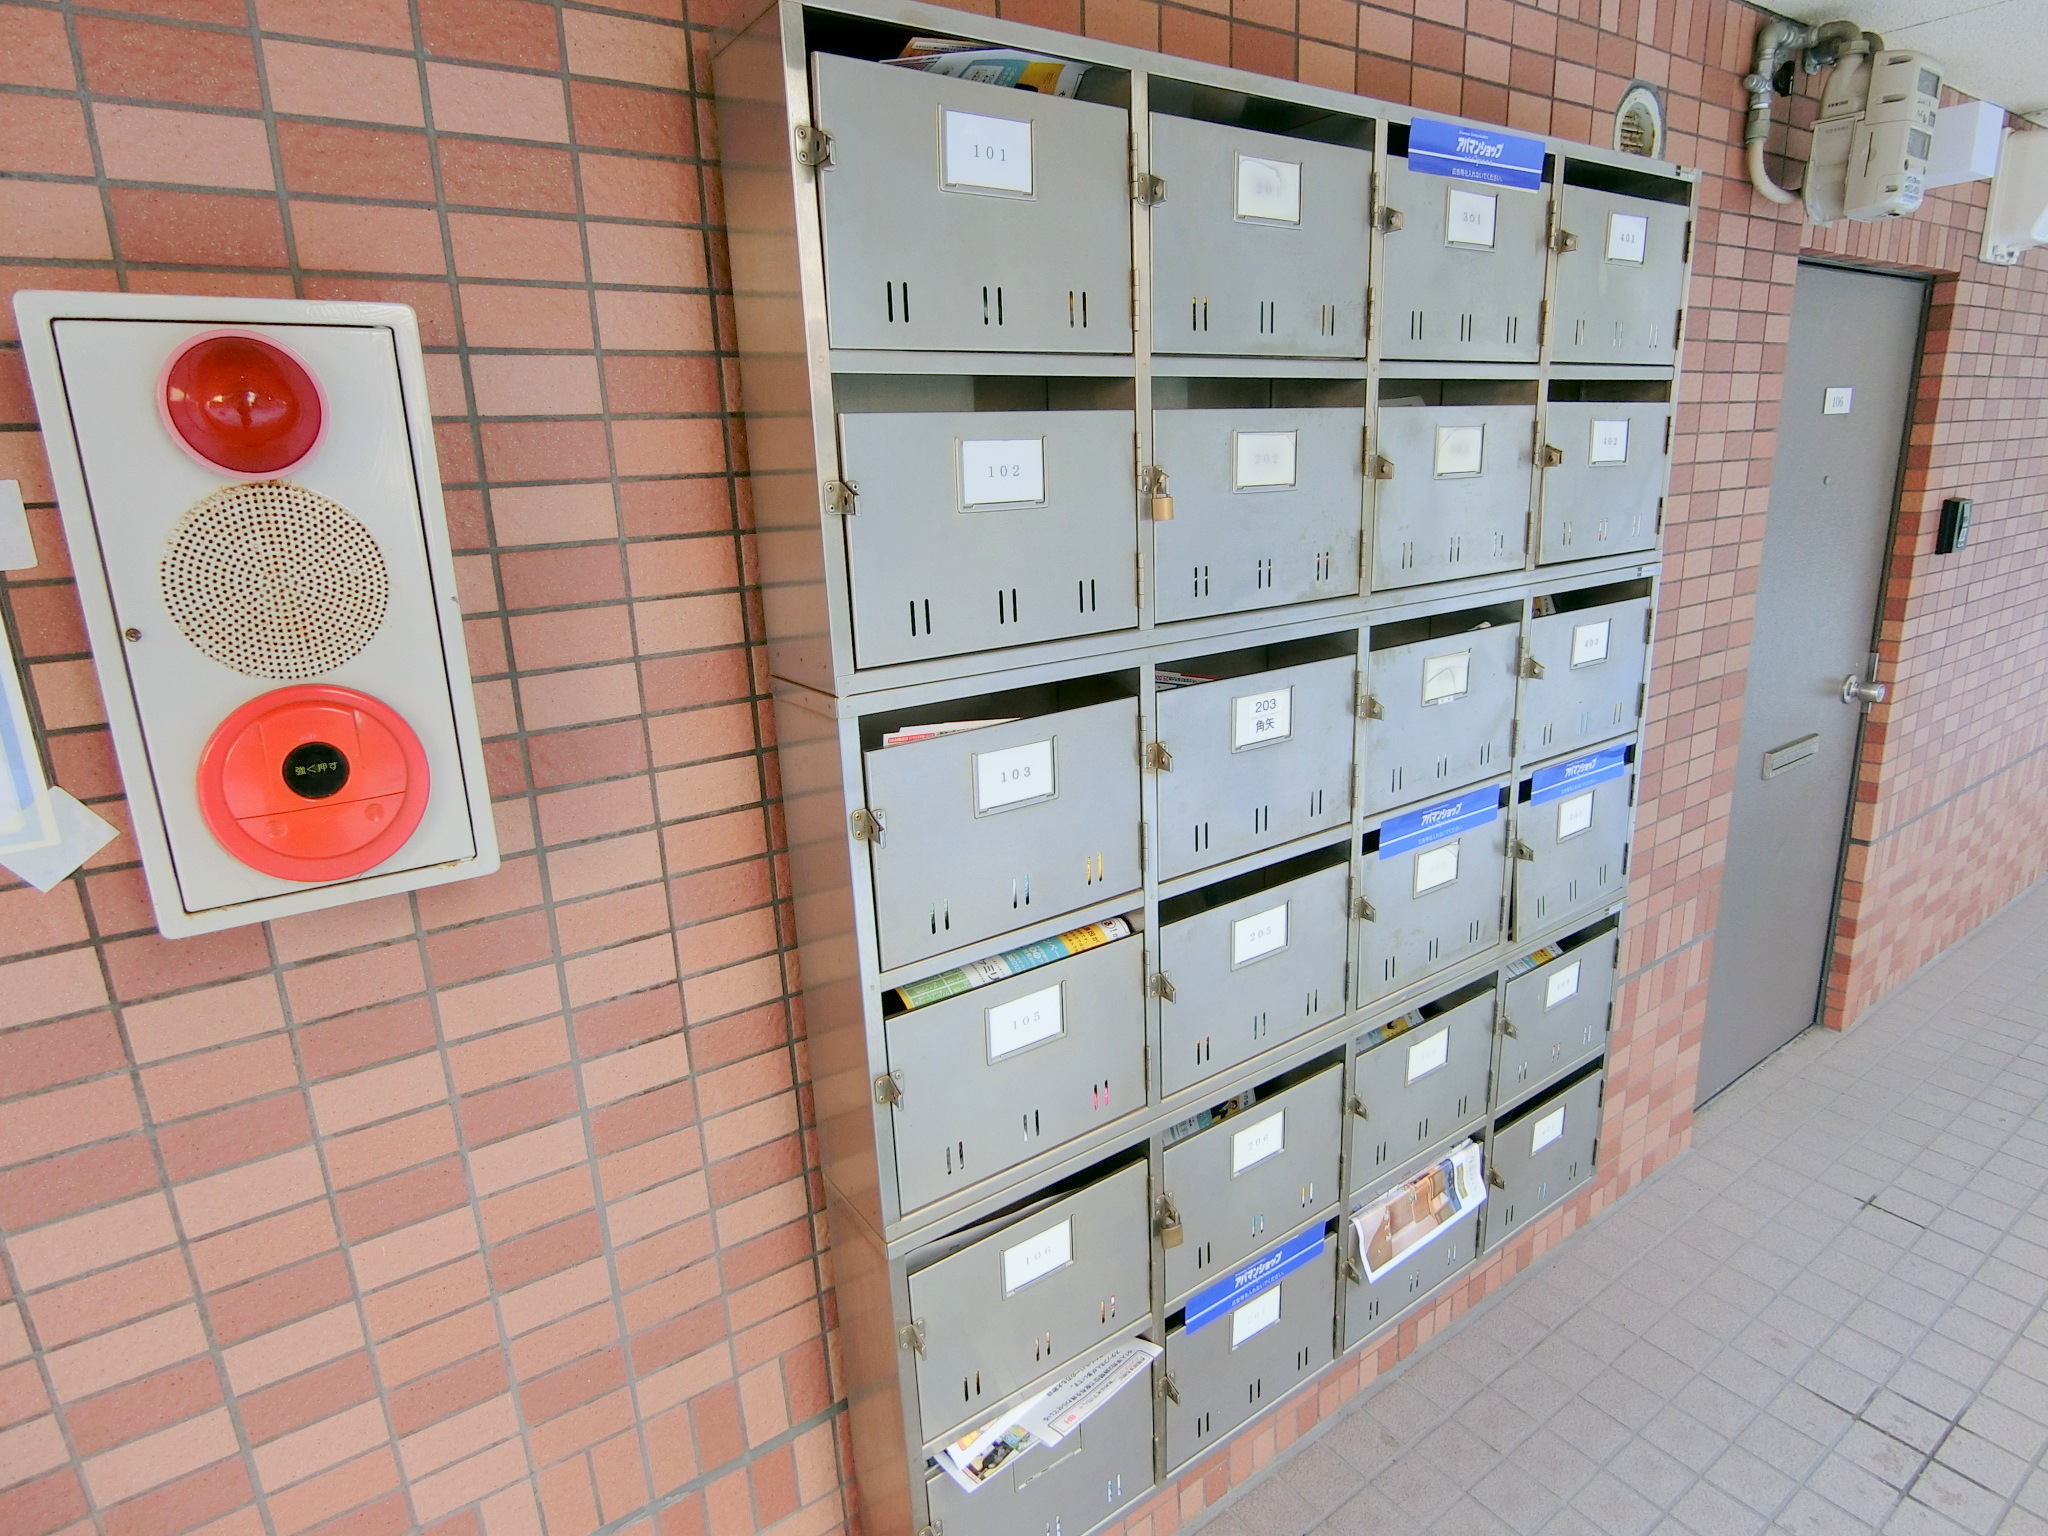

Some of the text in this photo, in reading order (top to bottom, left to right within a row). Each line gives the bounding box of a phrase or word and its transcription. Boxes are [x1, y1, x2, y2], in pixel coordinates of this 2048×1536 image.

[973, 144, 1007, 163] 101
[1456, 137, 1504, 158] アパマンショップ
[1463, 211, 1481, 225] 301
[1619, 233, 1635, 245] 401
[1602, 436, 1617, 446] 402
[1254, 452, 1279, 466] 202
[987, 464, 1021, 478] 102
[1255, 698, 1277, 713] 203
[1256, 717, 1275, 734] 角矢
[295, 761, 337, 776] 強く押す
[1000, 765, 1032, 783] 103
[1421, 802, 1463, 826] アパマンショップ
[1249, 925, 1272, 942] 205
[1012, 1011, 1041, 1031] 105
[1248, 1133, 1269, 1151] 206
[1025, 1246, 1051, 1265] 106
[1234, 1251, 1283, 1289] アパマンショップ
